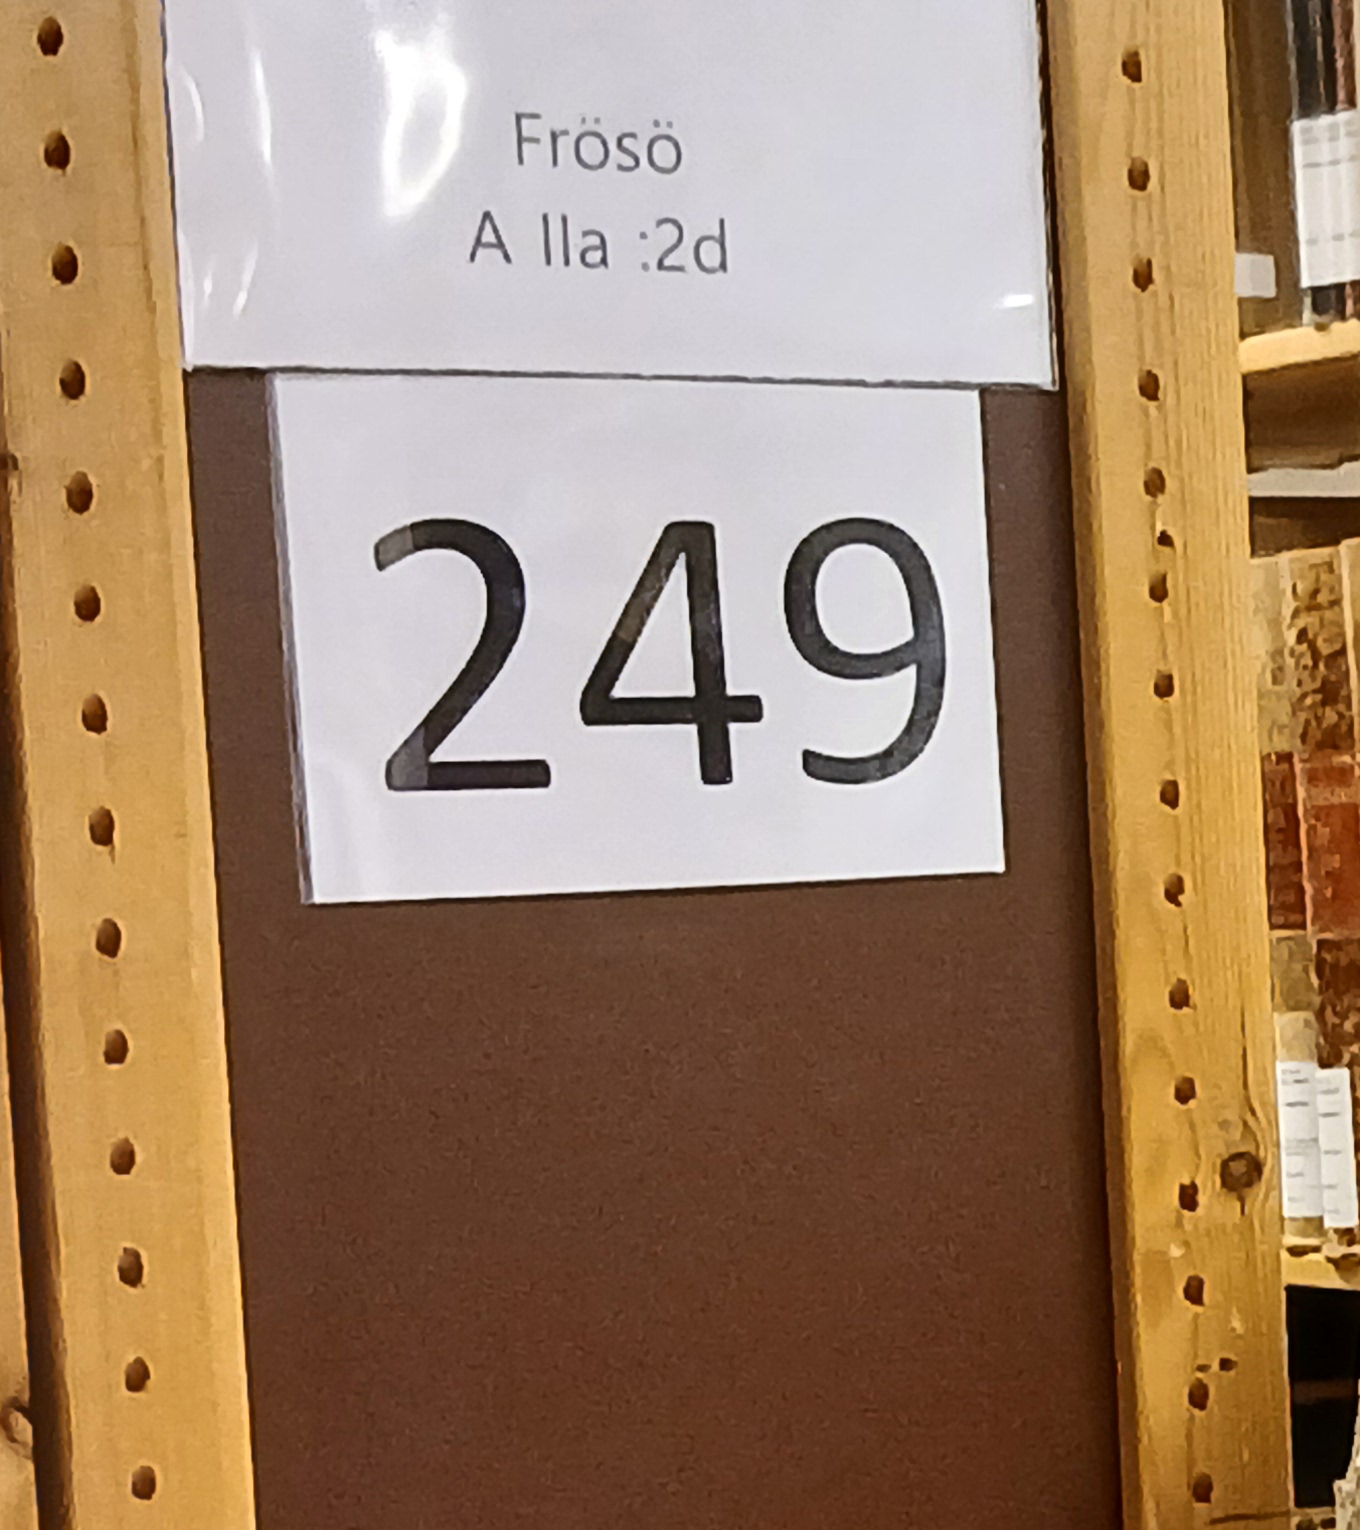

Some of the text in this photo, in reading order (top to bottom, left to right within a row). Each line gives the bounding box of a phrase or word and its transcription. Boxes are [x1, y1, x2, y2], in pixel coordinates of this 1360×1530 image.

[515, 112, 683, 175] Frösö
[469, 210, 512, 264] A
[374, 518, 947, 792] 249
